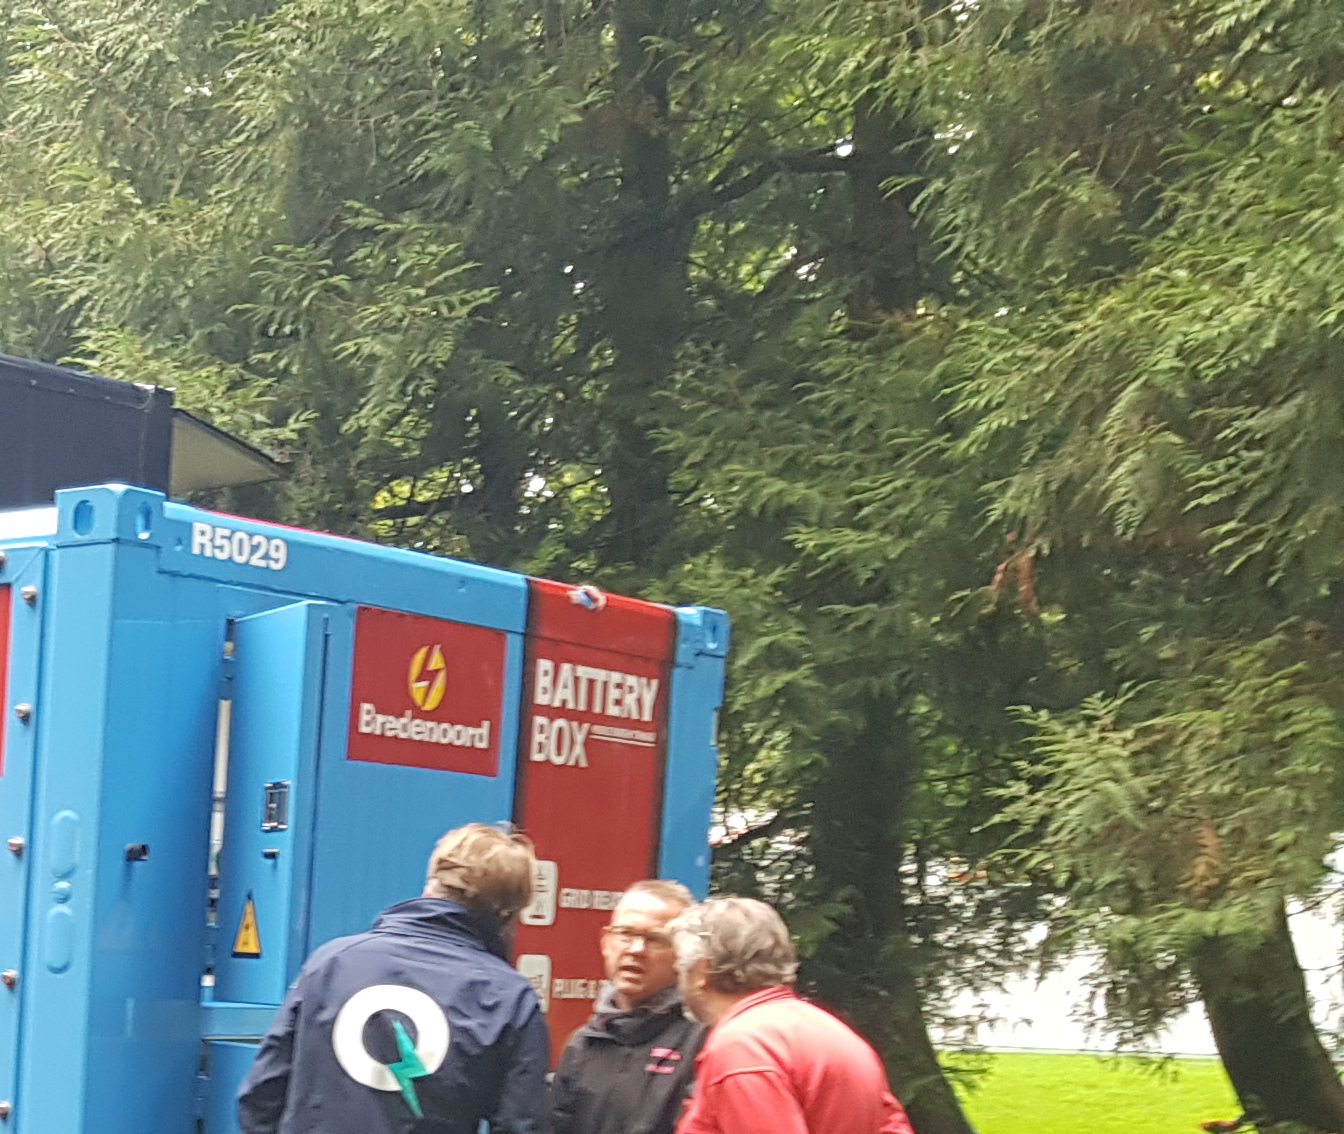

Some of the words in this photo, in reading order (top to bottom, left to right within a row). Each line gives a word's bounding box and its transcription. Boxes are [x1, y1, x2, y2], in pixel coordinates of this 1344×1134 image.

[190, 520, 288, 571] R5029
[533, 658, 660, 722] BATTERY
[358, 703, 490, 750] Bredenoord
[529, 715, 591, 768] BOX
